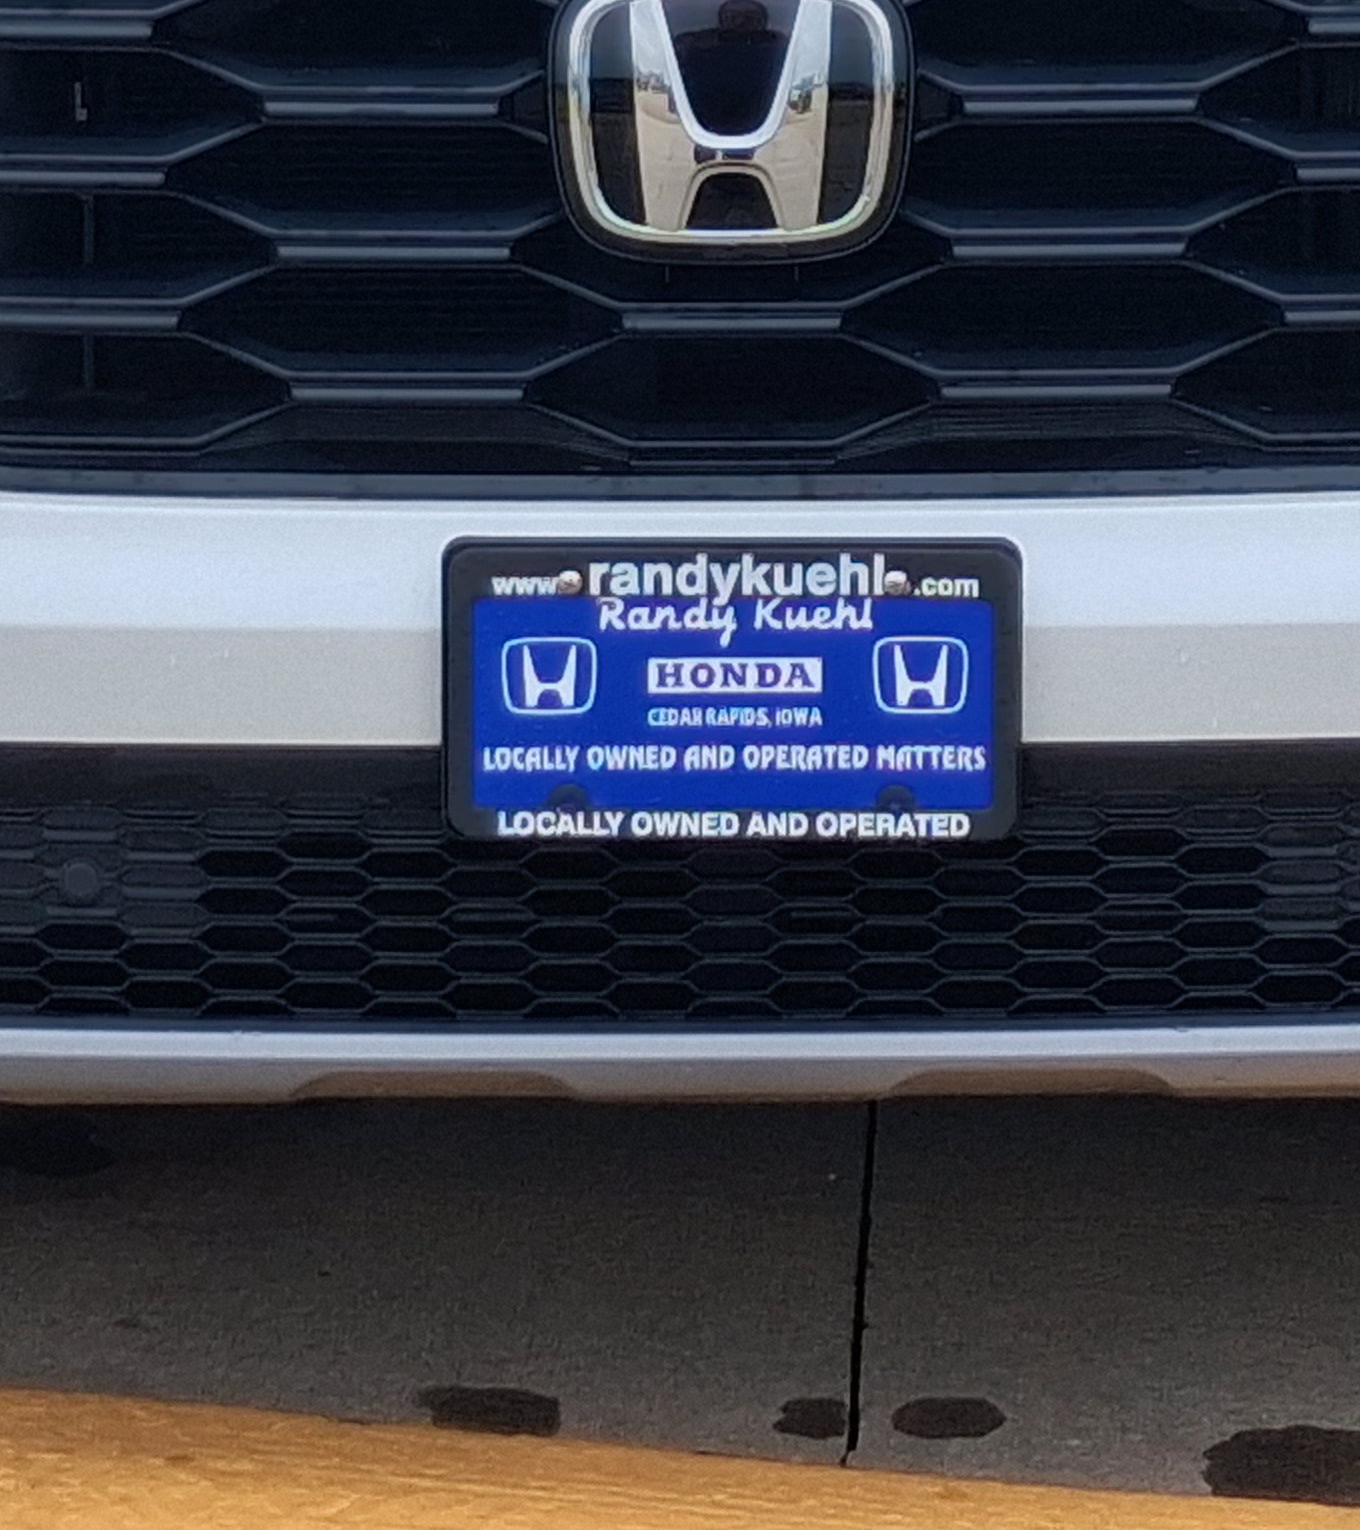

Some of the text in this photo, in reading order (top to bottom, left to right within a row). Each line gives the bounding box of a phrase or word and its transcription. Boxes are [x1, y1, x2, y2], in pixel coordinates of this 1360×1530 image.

[589, 553, 886, 606] randykuehl
[596, 596, 874, 648] Randy Kuehl
[655, 662, 815, 689] HONDA
[647, 706, 703, 727] CEDAR
[482, 744, 987, 772] LOCALLY OWNED AND OPERATED MATTERS
[496, 810, 971, 838] LOCALLY OWNED AND OPERATED
